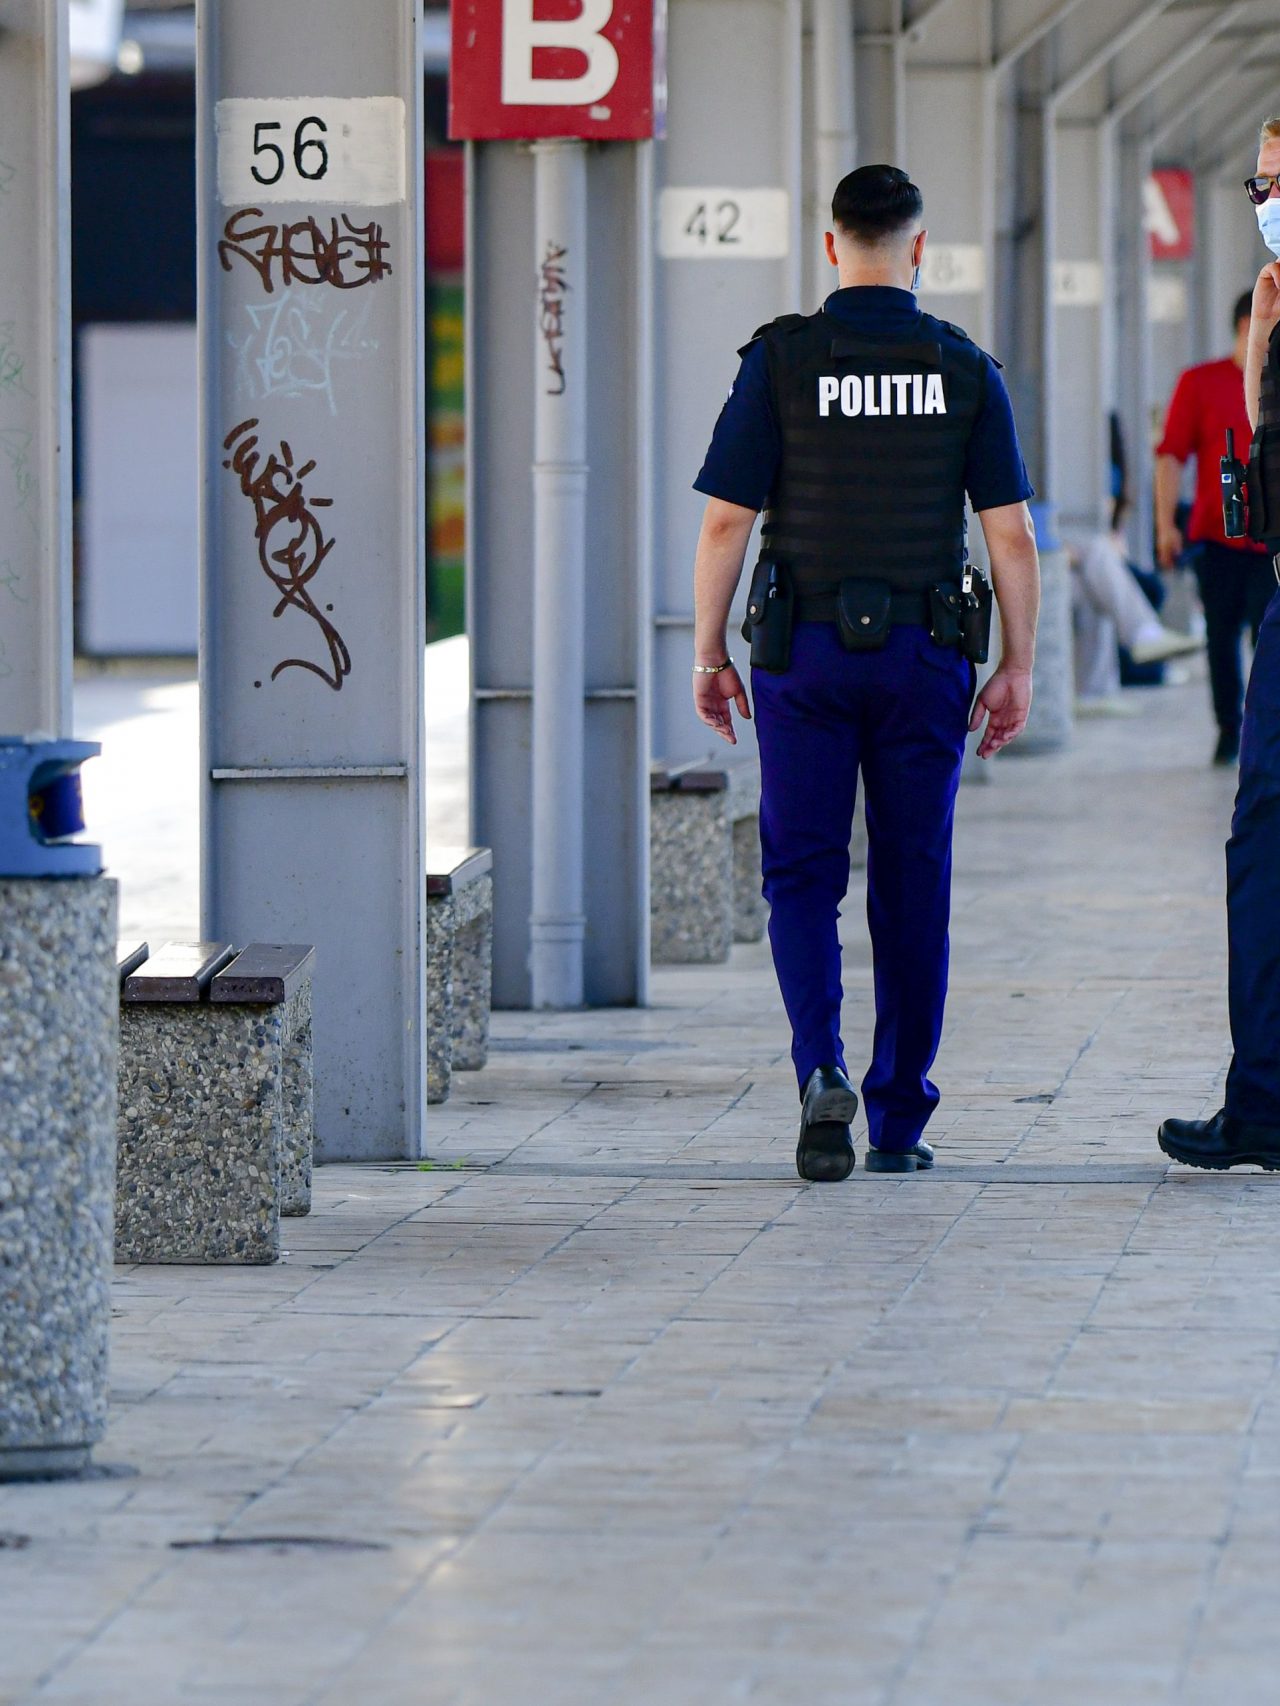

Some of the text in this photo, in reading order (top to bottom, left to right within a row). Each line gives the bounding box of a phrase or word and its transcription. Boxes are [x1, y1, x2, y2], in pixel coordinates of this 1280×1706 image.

[501, 0, 619, 105] B
[251, 106, 328, 185] 56
[684, 200, 741, 244] 42
[819, 374, 947, 417] POLITIA
